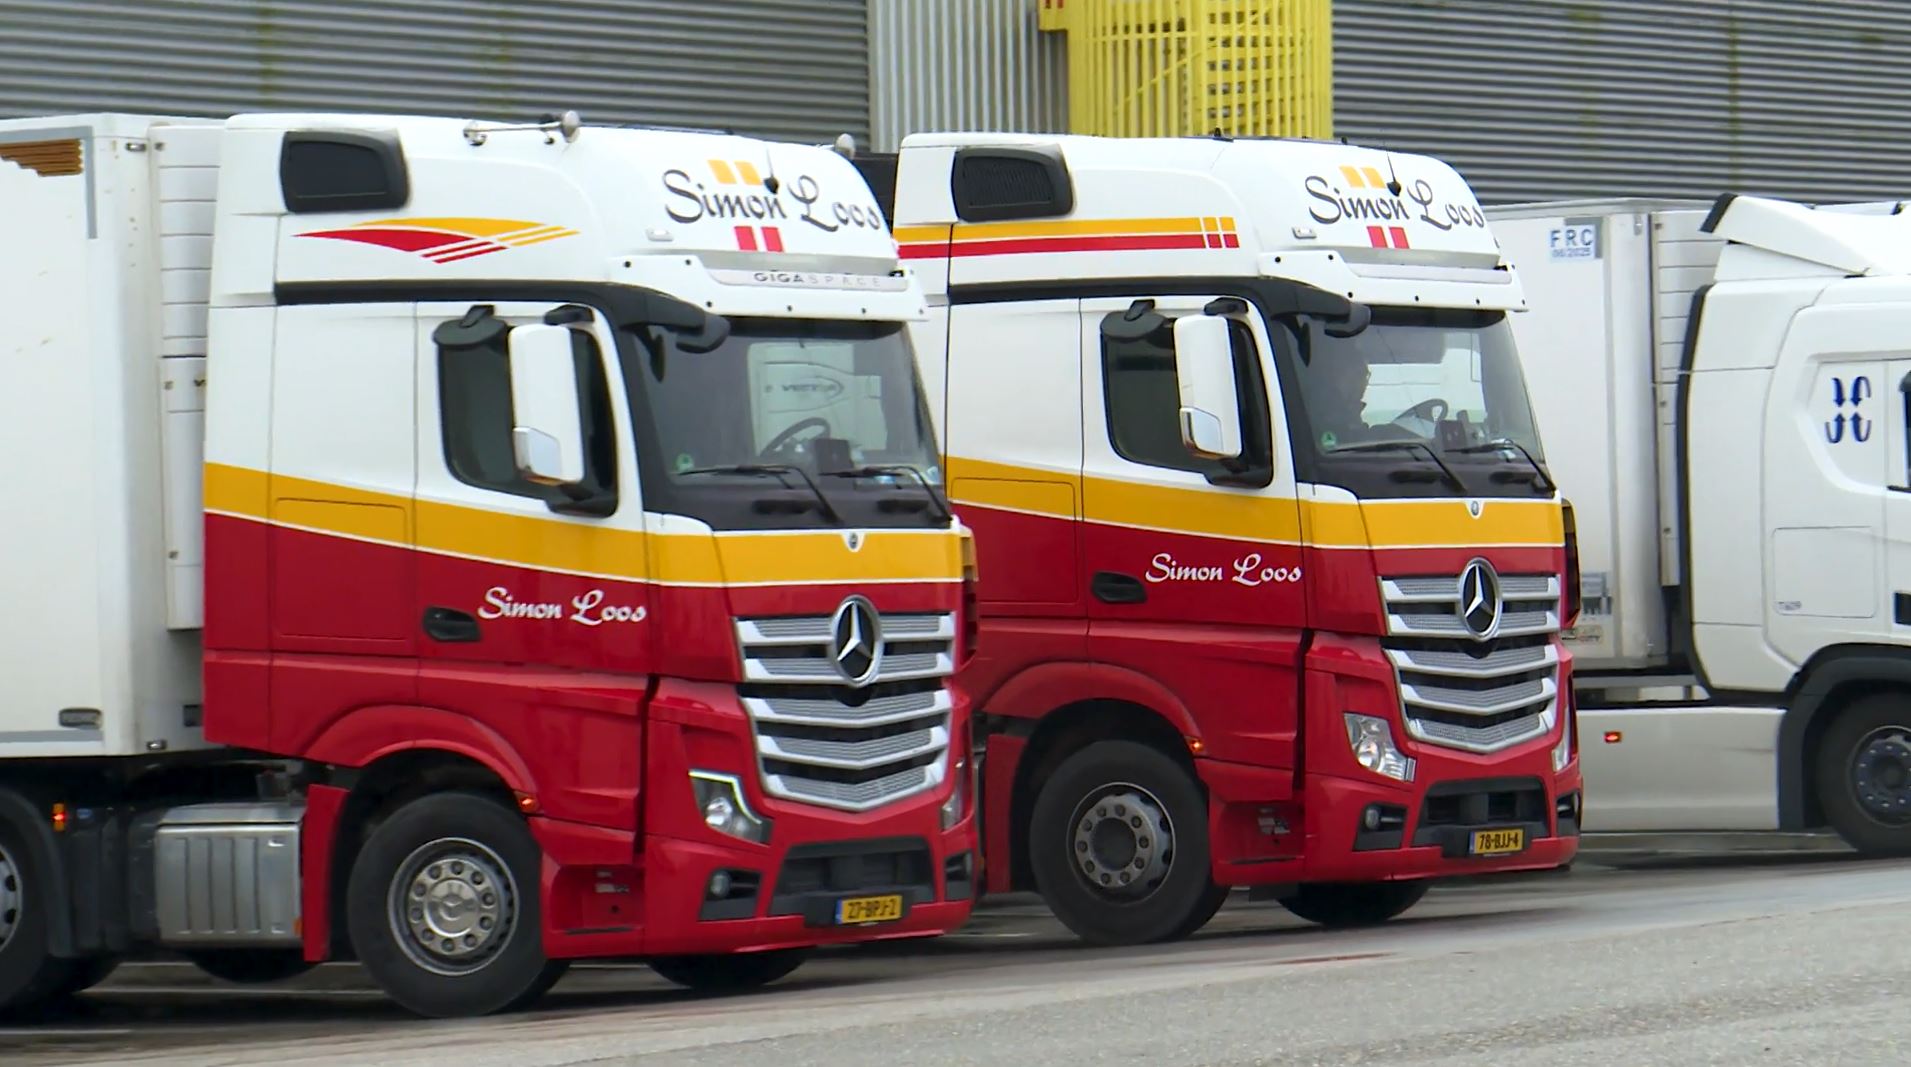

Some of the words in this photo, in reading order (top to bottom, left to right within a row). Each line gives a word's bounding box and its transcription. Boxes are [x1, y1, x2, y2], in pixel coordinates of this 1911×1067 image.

[662, 169, 787, 224] Simon
[786, 175, 881, 232] Loos
[1304, 175, 1410, 225] Simon
[1406, 179, 1485, 231] Loos
[1550, 228, 1594, 248] FRC
[1145, 553, 1223, 583] Simon
[1231, 553, 1302, 587] Loos
[477, 586, 562, 620] Simon
[569, 589, 647, 626] Loos
